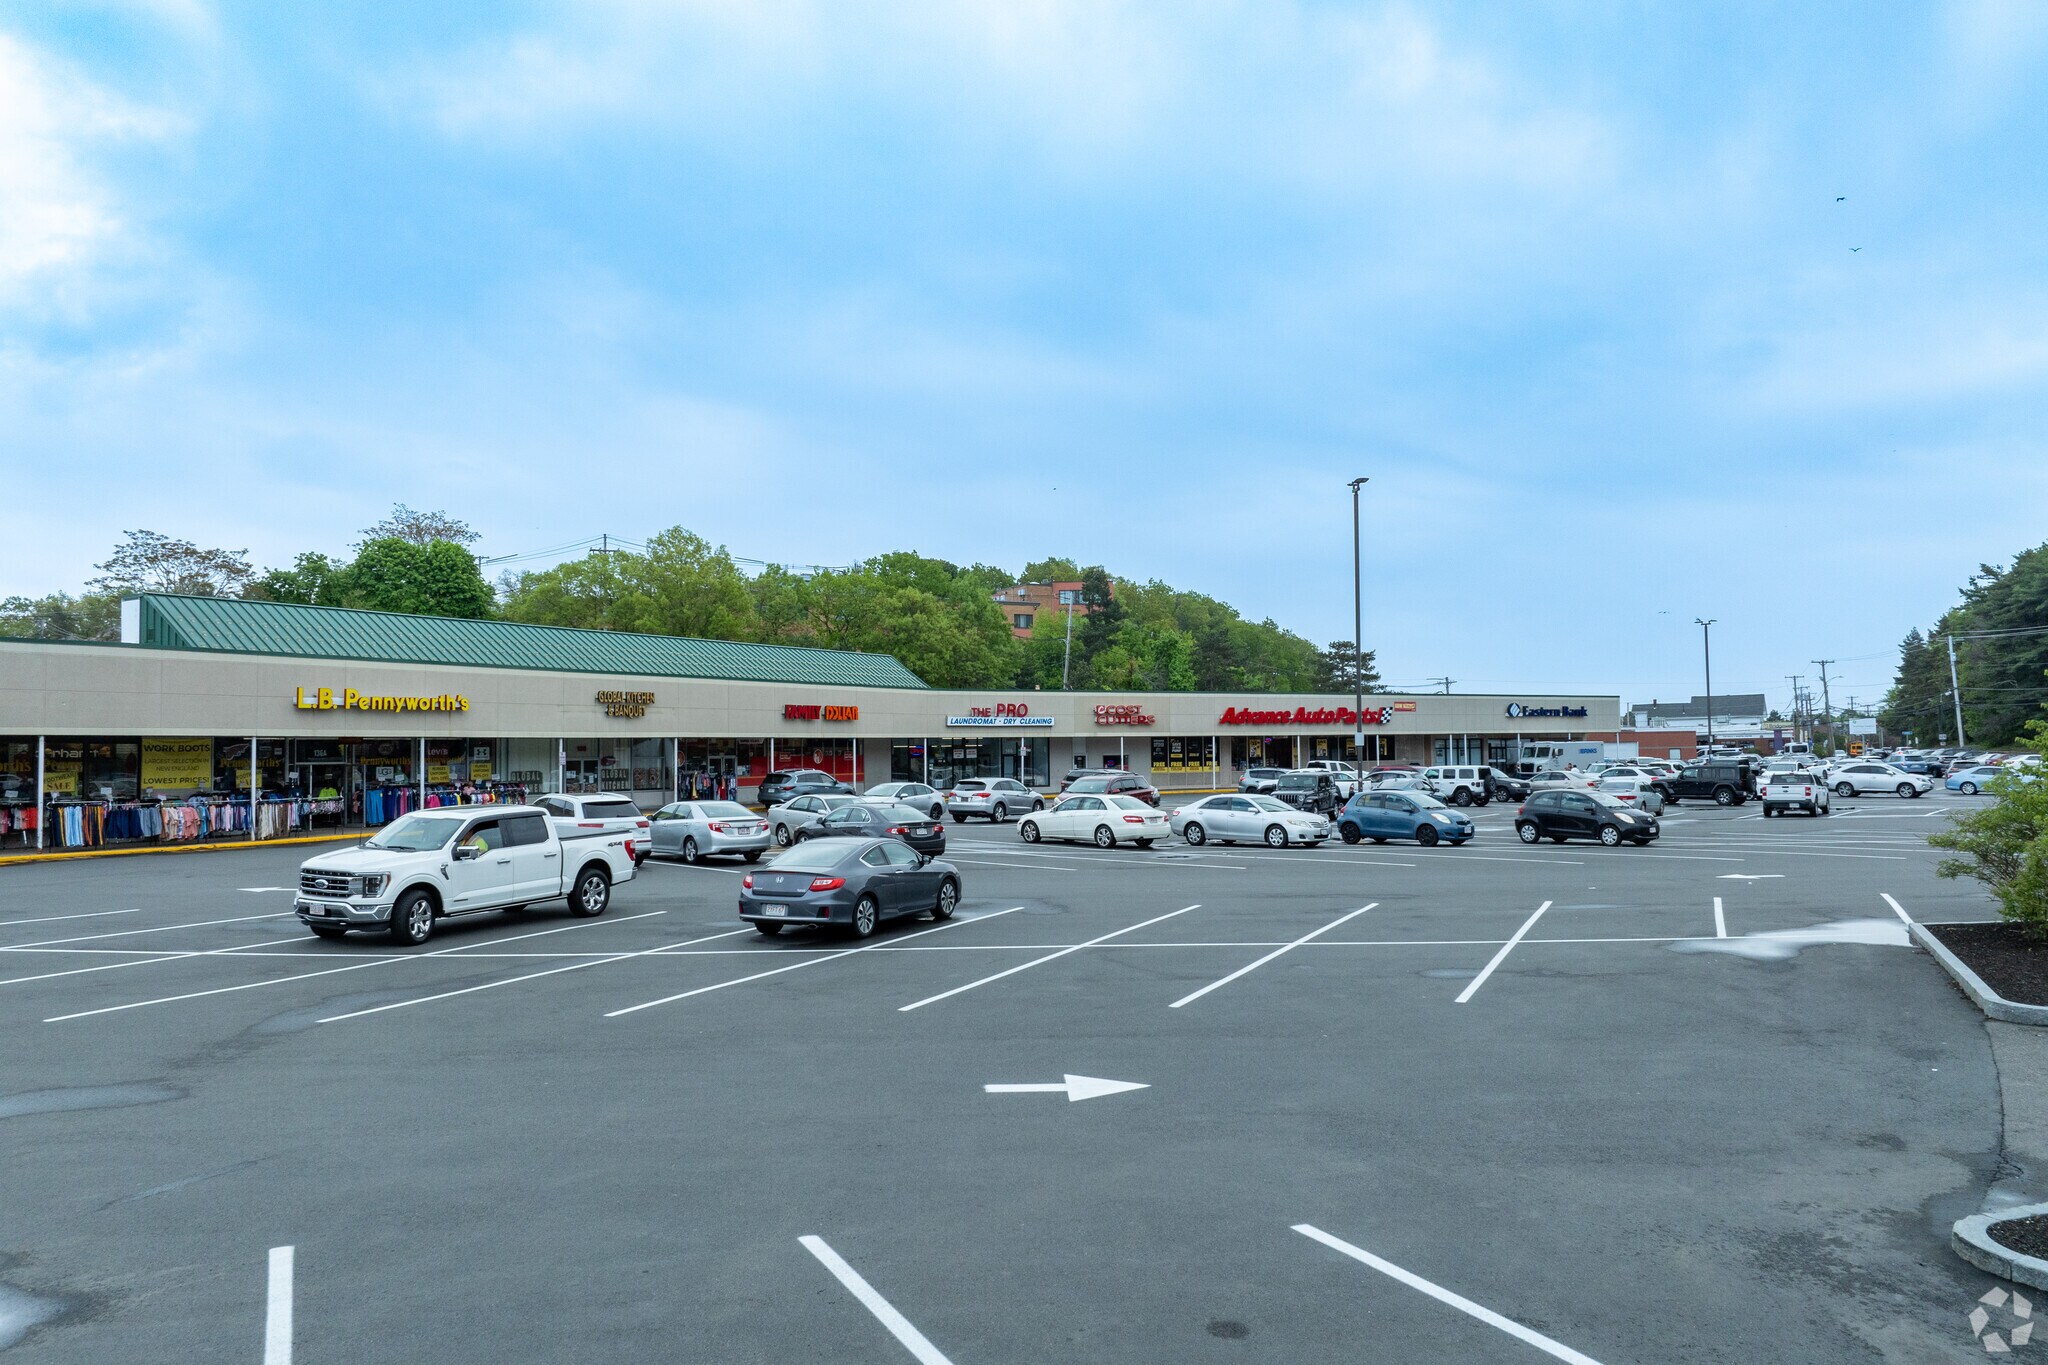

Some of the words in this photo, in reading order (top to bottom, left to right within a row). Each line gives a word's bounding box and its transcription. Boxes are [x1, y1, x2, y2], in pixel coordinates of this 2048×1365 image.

[297, 687, 338, 710] L.B.
[344, 687, 470, 712] Pennyworth's
[598, 690, 625, 703] GLOBAL
[626, 691, 655, 704] KITCHEN
[607, 704, 614, 716] &
[614, 704, 645, 719] BANQUET
[784, 704, 821, 720] FAMILY
[824, 705, 858, 720] DOLLAR
[971, 707, 991, 717] THE
[995, 703, 1028, 717] PRO
[1106, 704, 1143, 715] COST
[1522, 705, 1560, 717] Eastern
[1562, 705, 1588, 717] Bank
[1097, 715, 1156, 725] CUTTERS
[1220, 707, 1292, 725] Advance
[1292, 706, 1332, 724] Auto
[1334, 706, 1377, 724] Pats
[1019, 717, 1053, 725] CLEANING
[144, 744, 175, 752] WORK
[178, 744, 210, 752] BOOTS
[377, 768, 393, 776] UGG
[511, 771, 540, 781] GLOBAL
[601, 769, 627, 779] GLOBAL
[46, 782, 72, 791] SALE
[601, 780, 631, 790] KITCHEN
